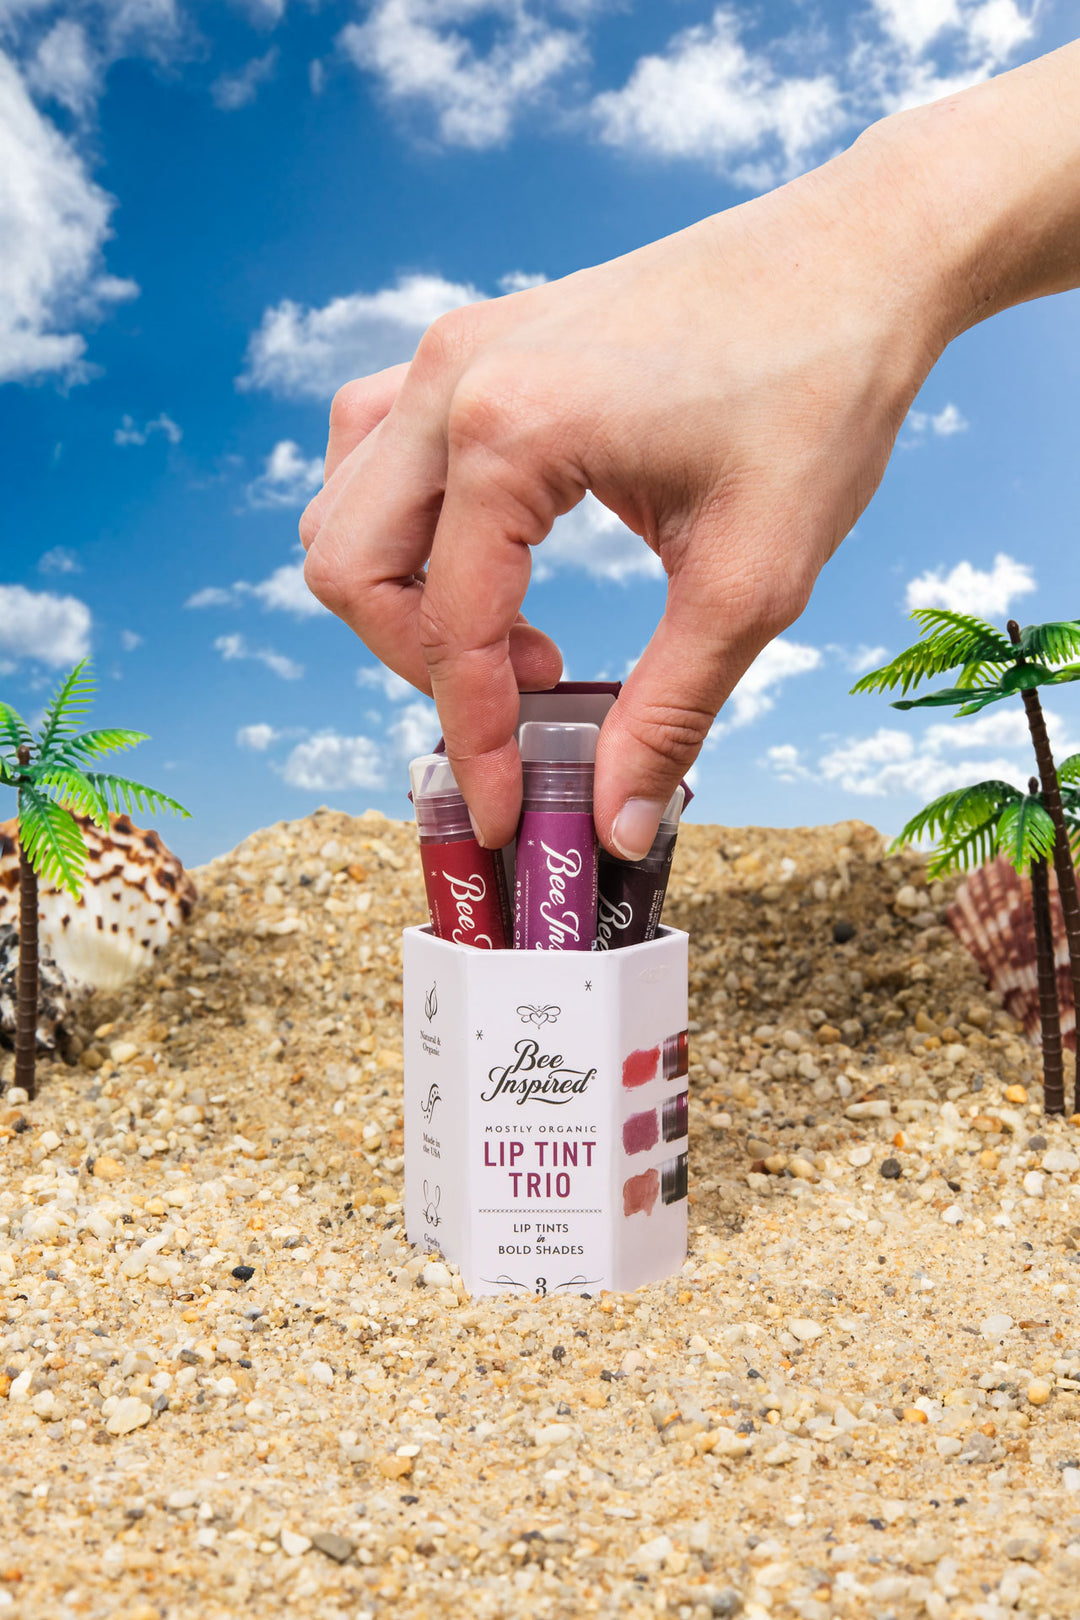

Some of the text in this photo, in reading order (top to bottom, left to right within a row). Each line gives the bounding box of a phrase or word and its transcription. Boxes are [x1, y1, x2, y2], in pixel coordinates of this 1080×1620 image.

[540, 840, 582, 906] Bee
[442, 870, 486, 931] Bee
[509, 1038, 565, 1074] Bee
[480, 1065, 597, 1105] Inspired
[423, 1132, 435, 1146] Made
[485, 1125, 597, 1133] MOSTLY ORGANIC
[422, 1144, 441, 1159] the USA
[484, 1141, 597, 1167] LIP TINT
[508, 1172, 571, 1198] TRIO
[513, 1223, 569, 1233] LIP TINTS
[536, 1234, 546, 1243] in
[498, 1245, 584, 1255] BOLD SHADES
[535, 1277, 547, 1299] 3
